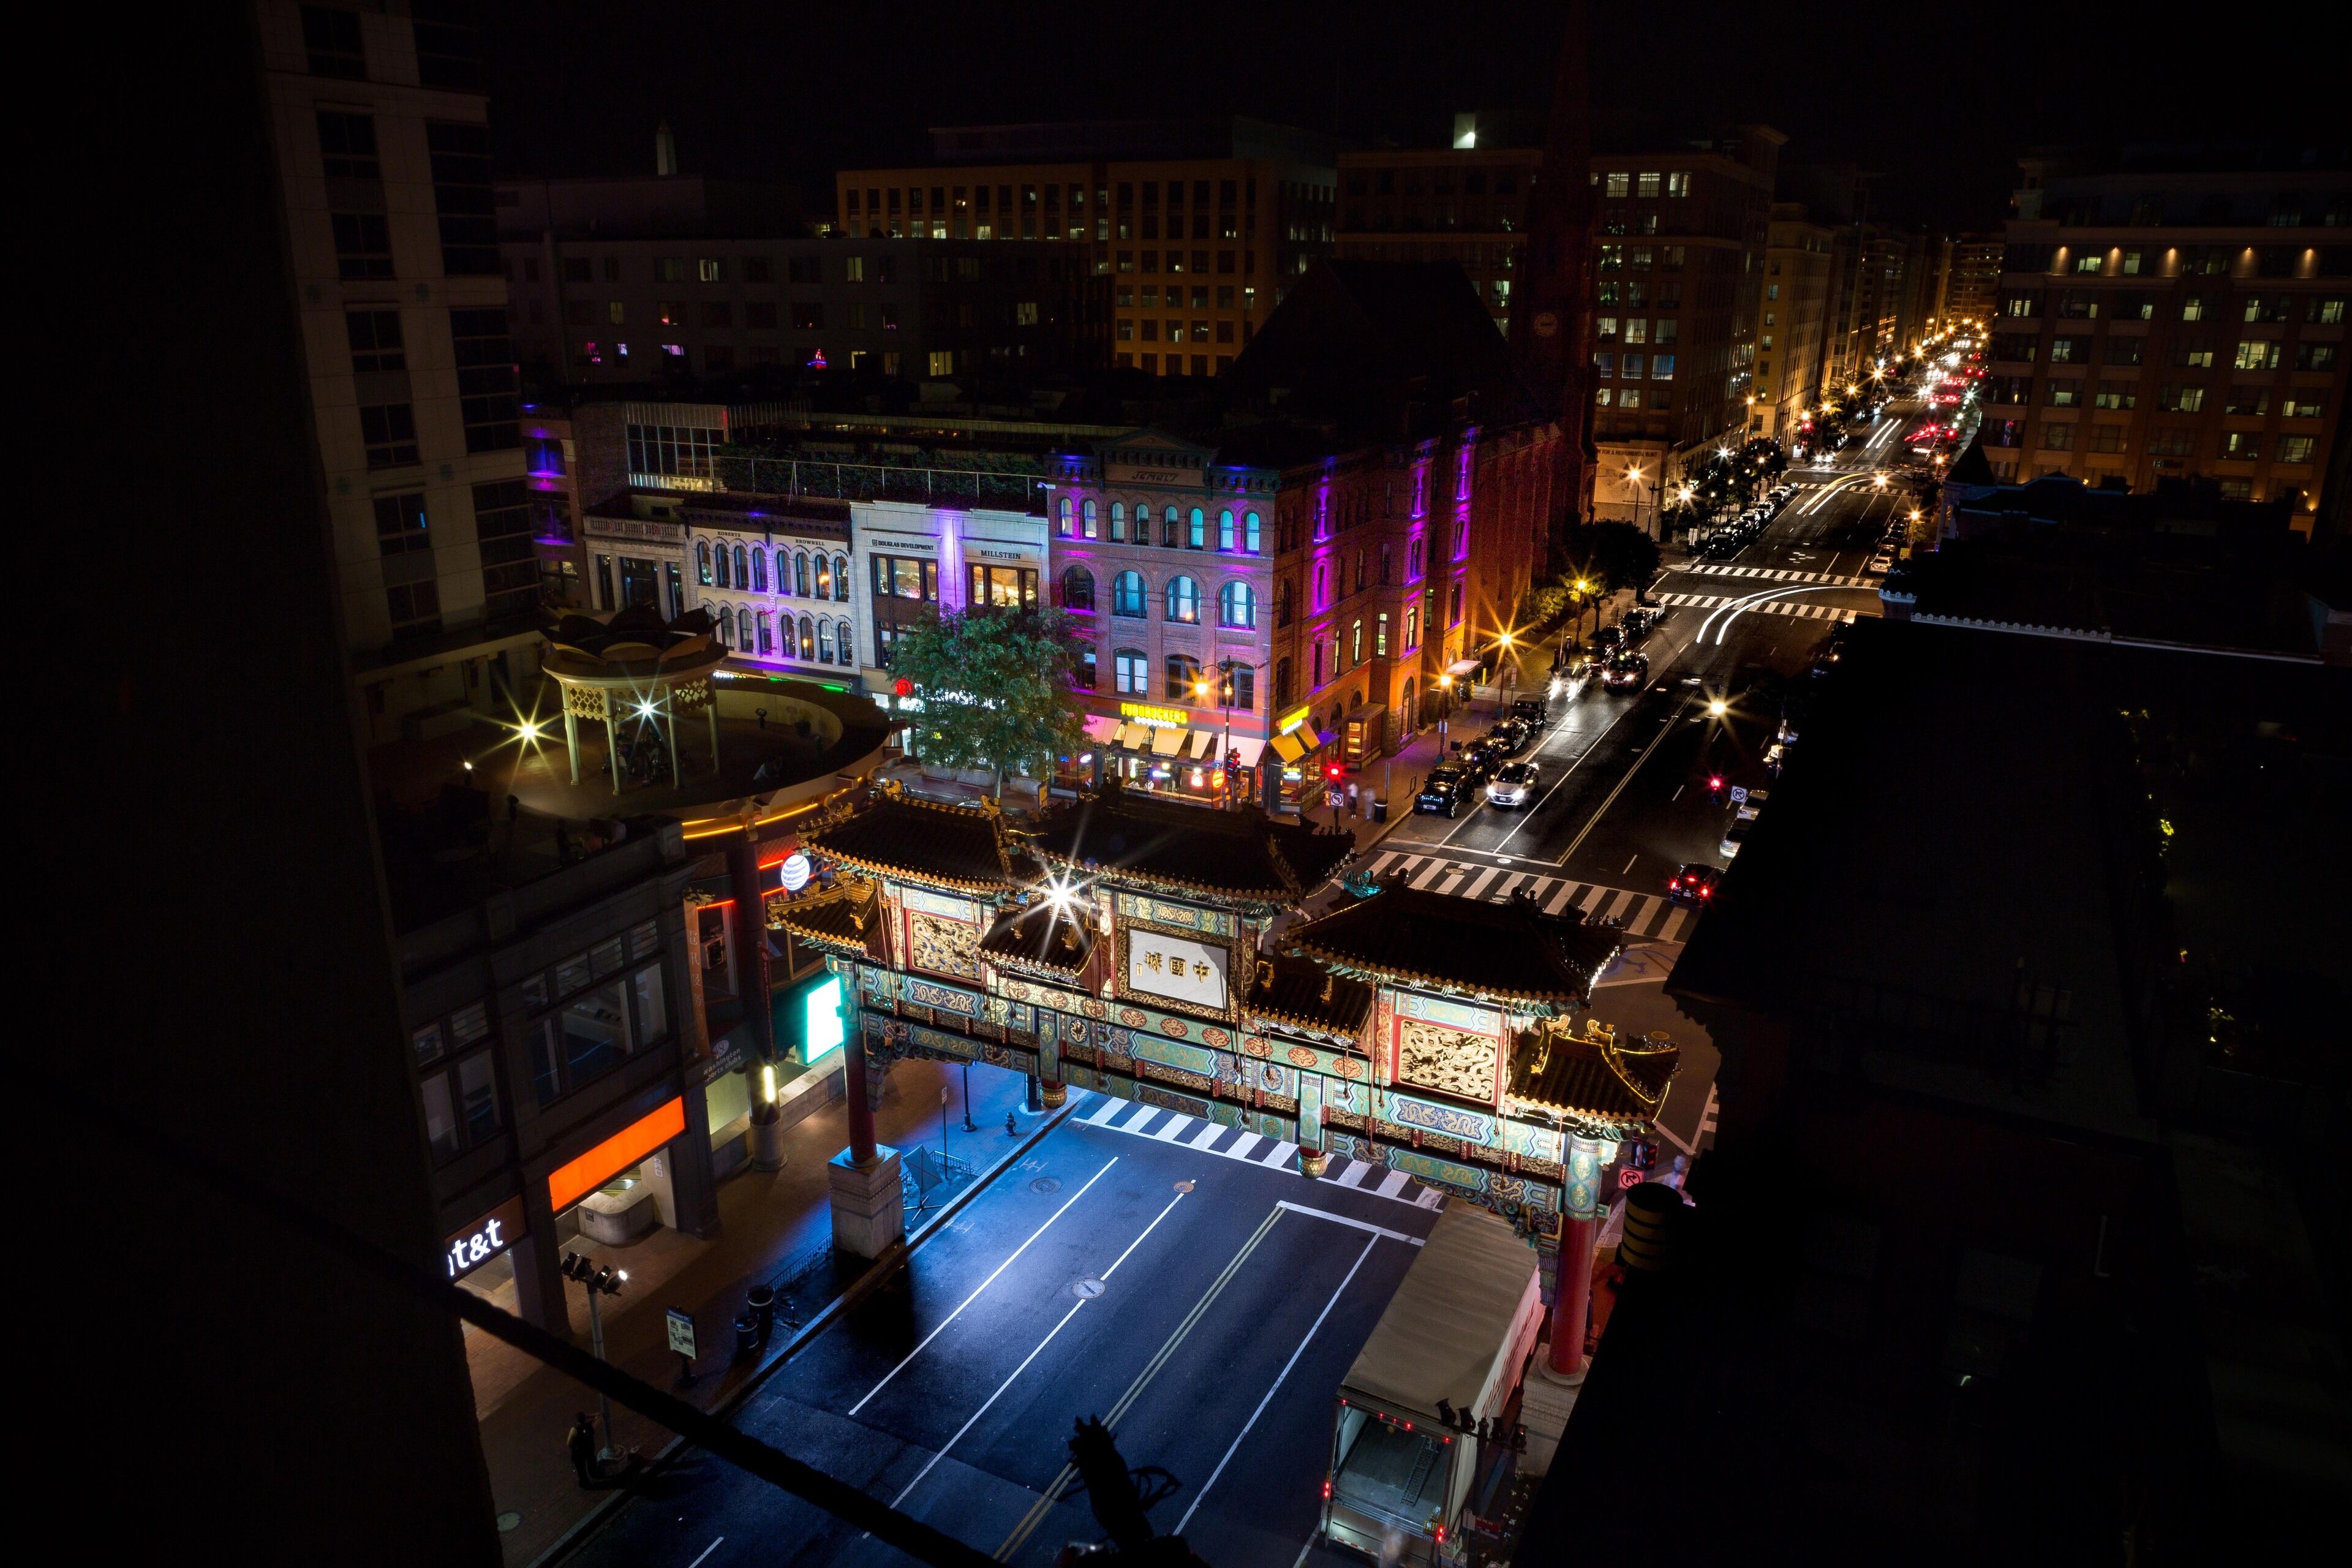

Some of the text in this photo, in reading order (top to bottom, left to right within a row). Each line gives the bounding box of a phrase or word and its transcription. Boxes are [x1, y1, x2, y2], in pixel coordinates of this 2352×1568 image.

[878, 540, 900, 548] DOUGLAS
[981, 550, 1021, 560] MILLSTEIN
[1121, 703, 1188, 725] FUDDRUCKERS
[725, 1055, 741, 1068] clubs
